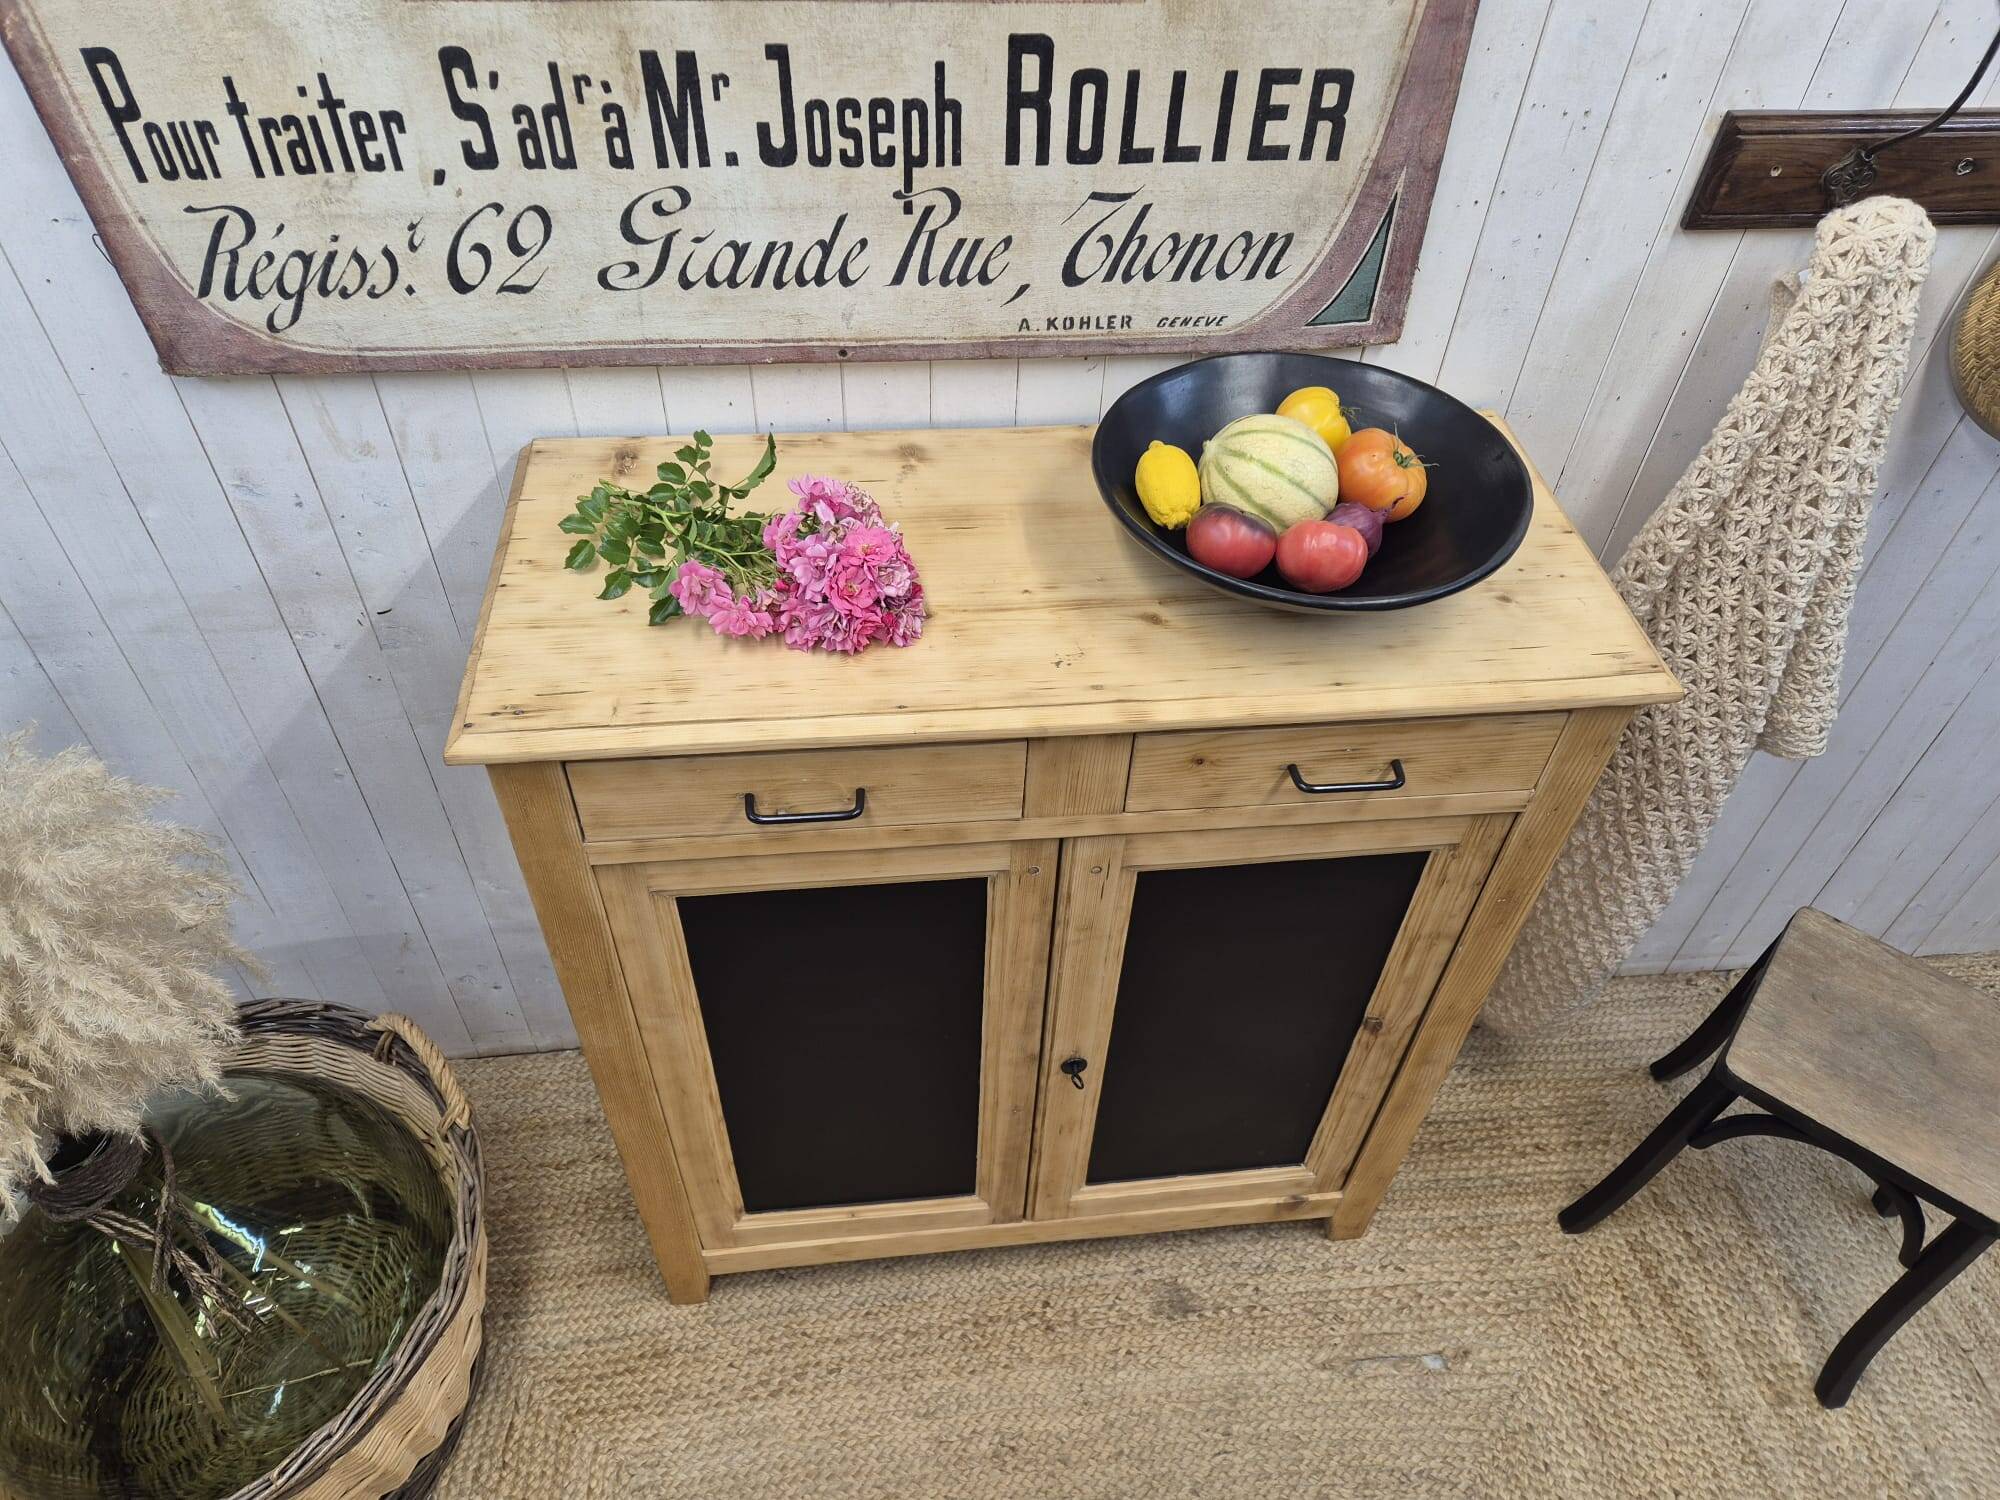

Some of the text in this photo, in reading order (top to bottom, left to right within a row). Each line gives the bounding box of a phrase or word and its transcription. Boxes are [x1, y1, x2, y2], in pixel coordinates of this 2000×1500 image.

[80, 47, 221, 183] Pour
[757, 43, 962, 214] Joseph
[1004, 33, 1355, 166] ROLLIER
[446, 202, 553, 295] 62
[598, 185, 869, 292] Grande
[886, 187, 1032, 307] Rue,
[1060, 185, 1295, 287] Thonon
[1046, 315, 1133, 331] KOHLER
